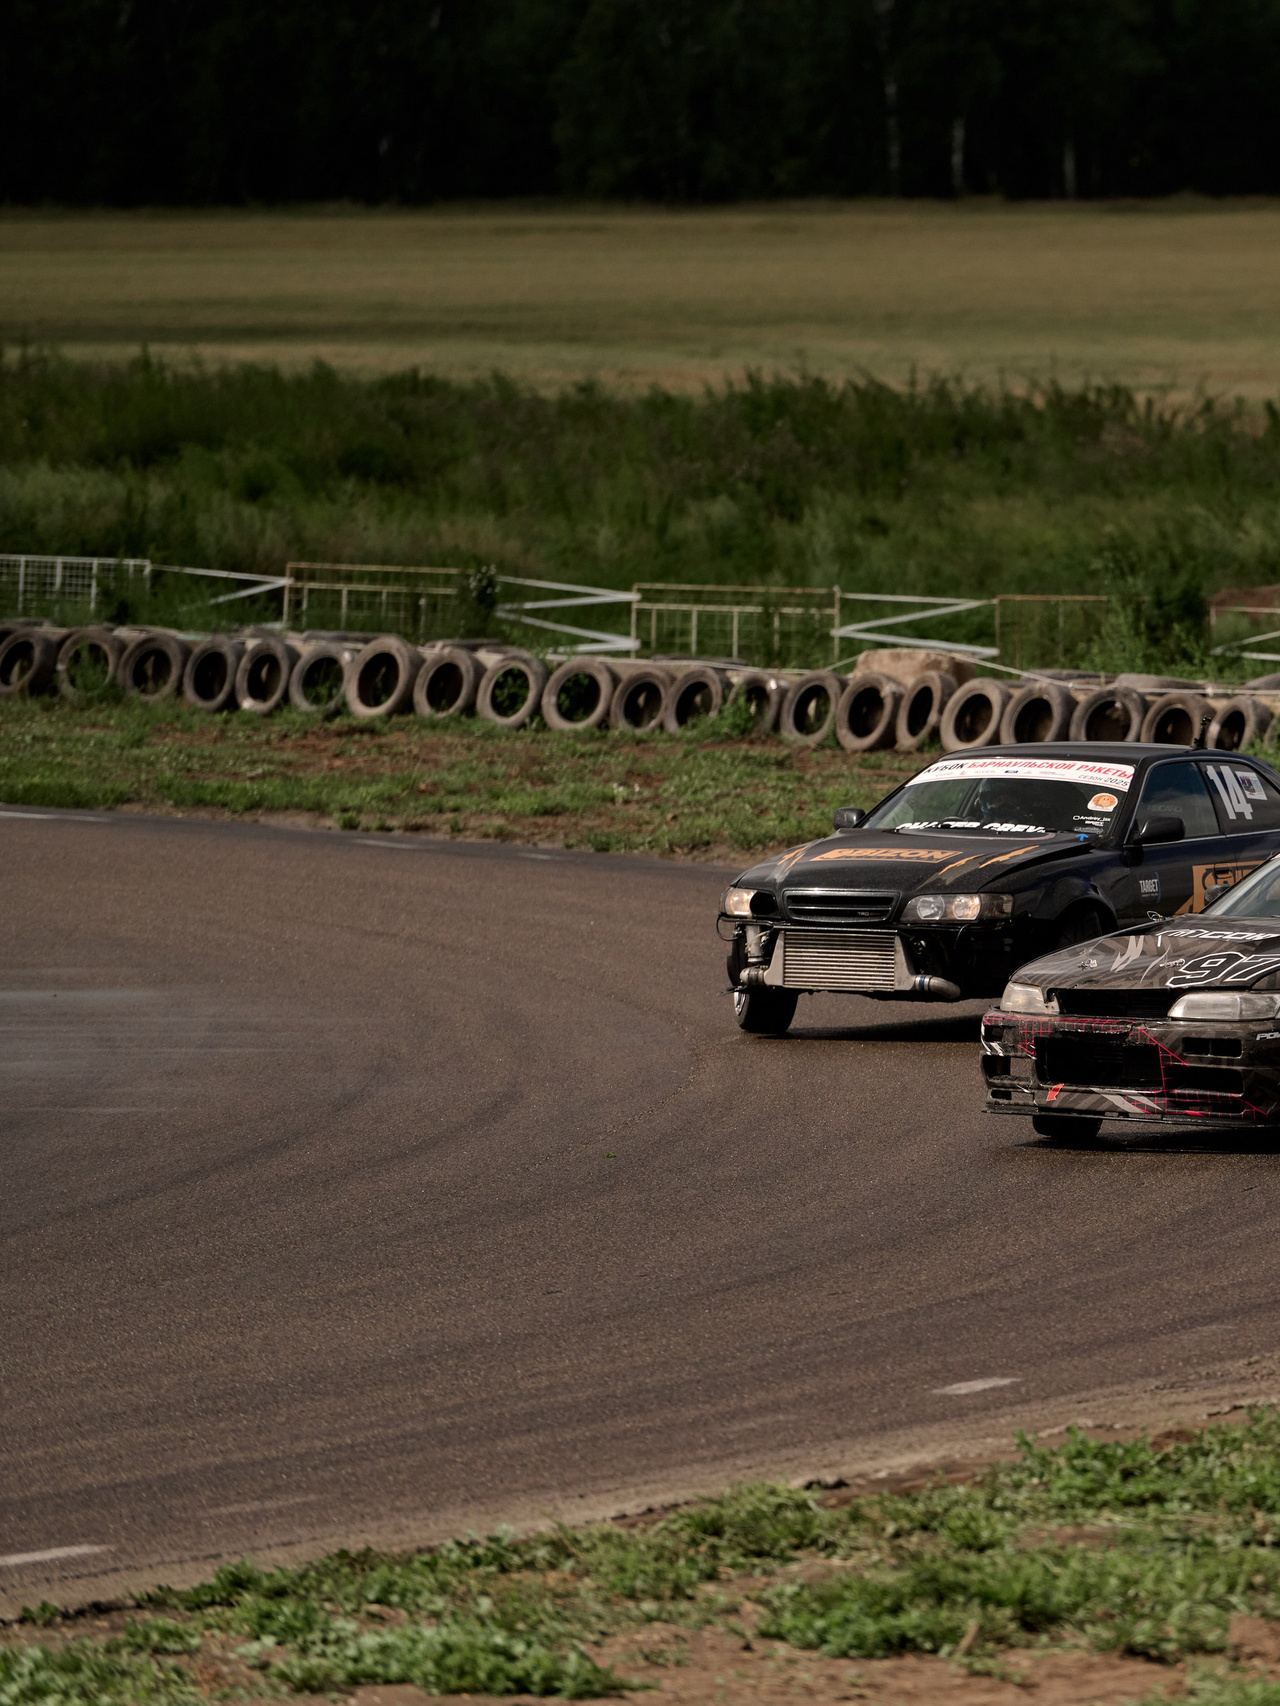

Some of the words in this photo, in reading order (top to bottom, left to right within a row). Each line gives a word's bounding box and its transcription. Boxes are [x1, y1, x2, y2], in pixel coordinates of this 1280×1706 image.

[925, 762, 968, 775] КУБОК
[968, 760, 1076, 771] БАРНАУЛЬСКОЙ
[1079, 774, 1104, 782] СЕЗОН
[1104, 776, 1129, 787] 2025
[1206, 765, 1253, 820] 14
[1139, 878, 1159, 893] TARGET
